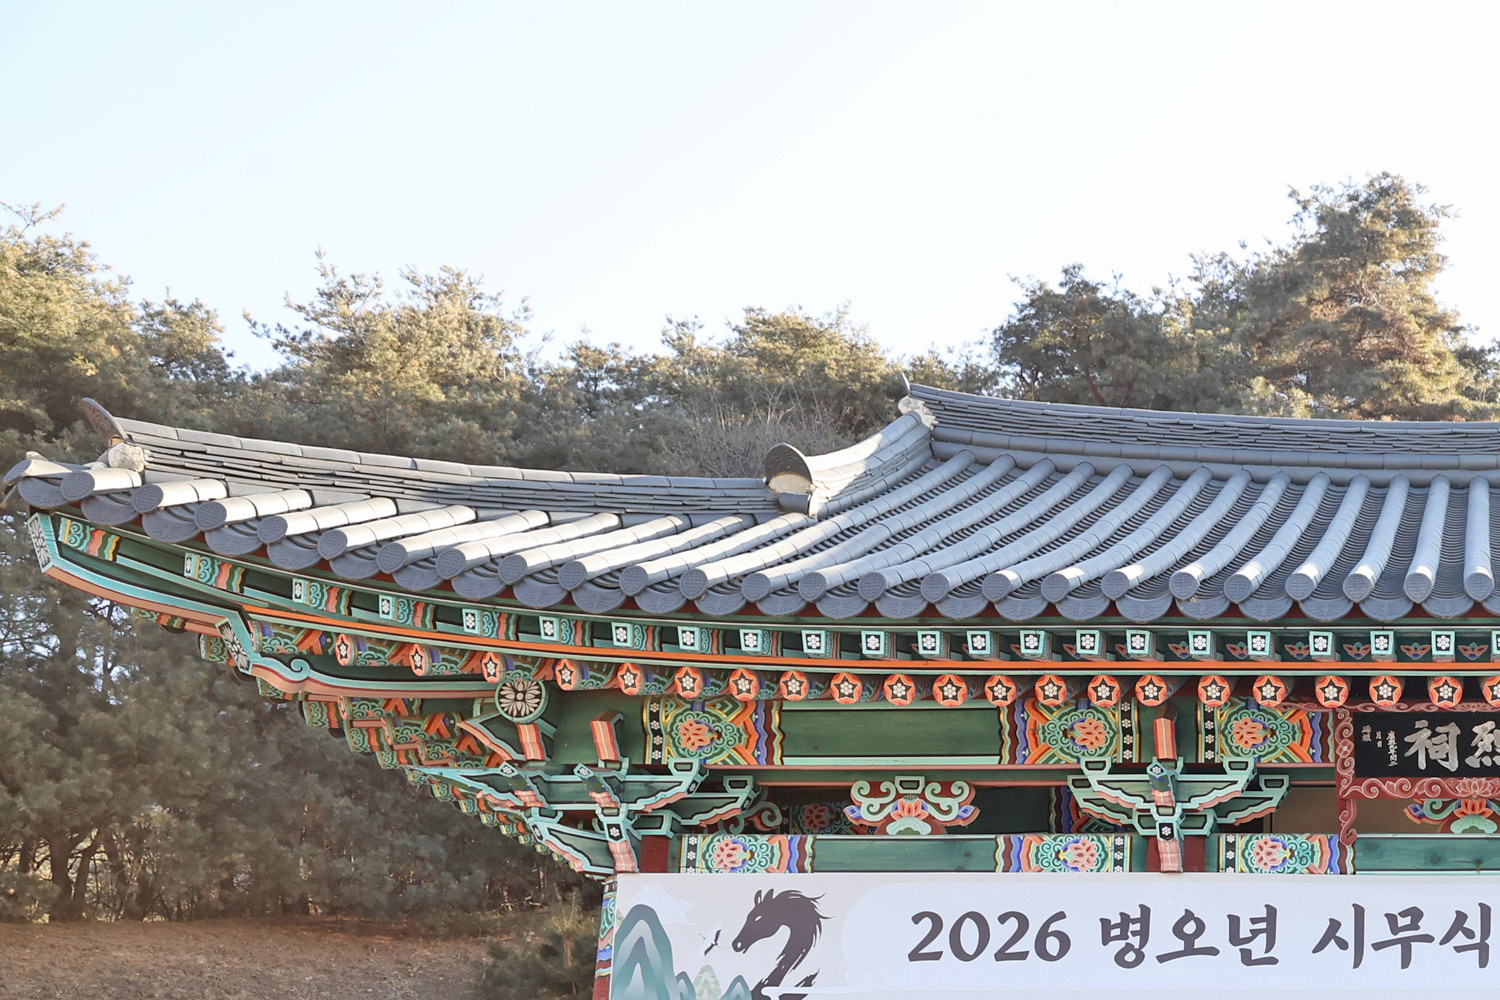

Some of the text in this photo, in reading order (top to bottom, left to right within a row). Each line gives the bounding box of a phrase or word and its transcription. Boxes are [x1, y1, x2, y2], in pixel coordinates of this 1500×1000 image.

[907, 910, 1072, 963] 2026
[1098, 903, 1281, 969] 병오년
[1311, 902, 1492, 970] 시무식
